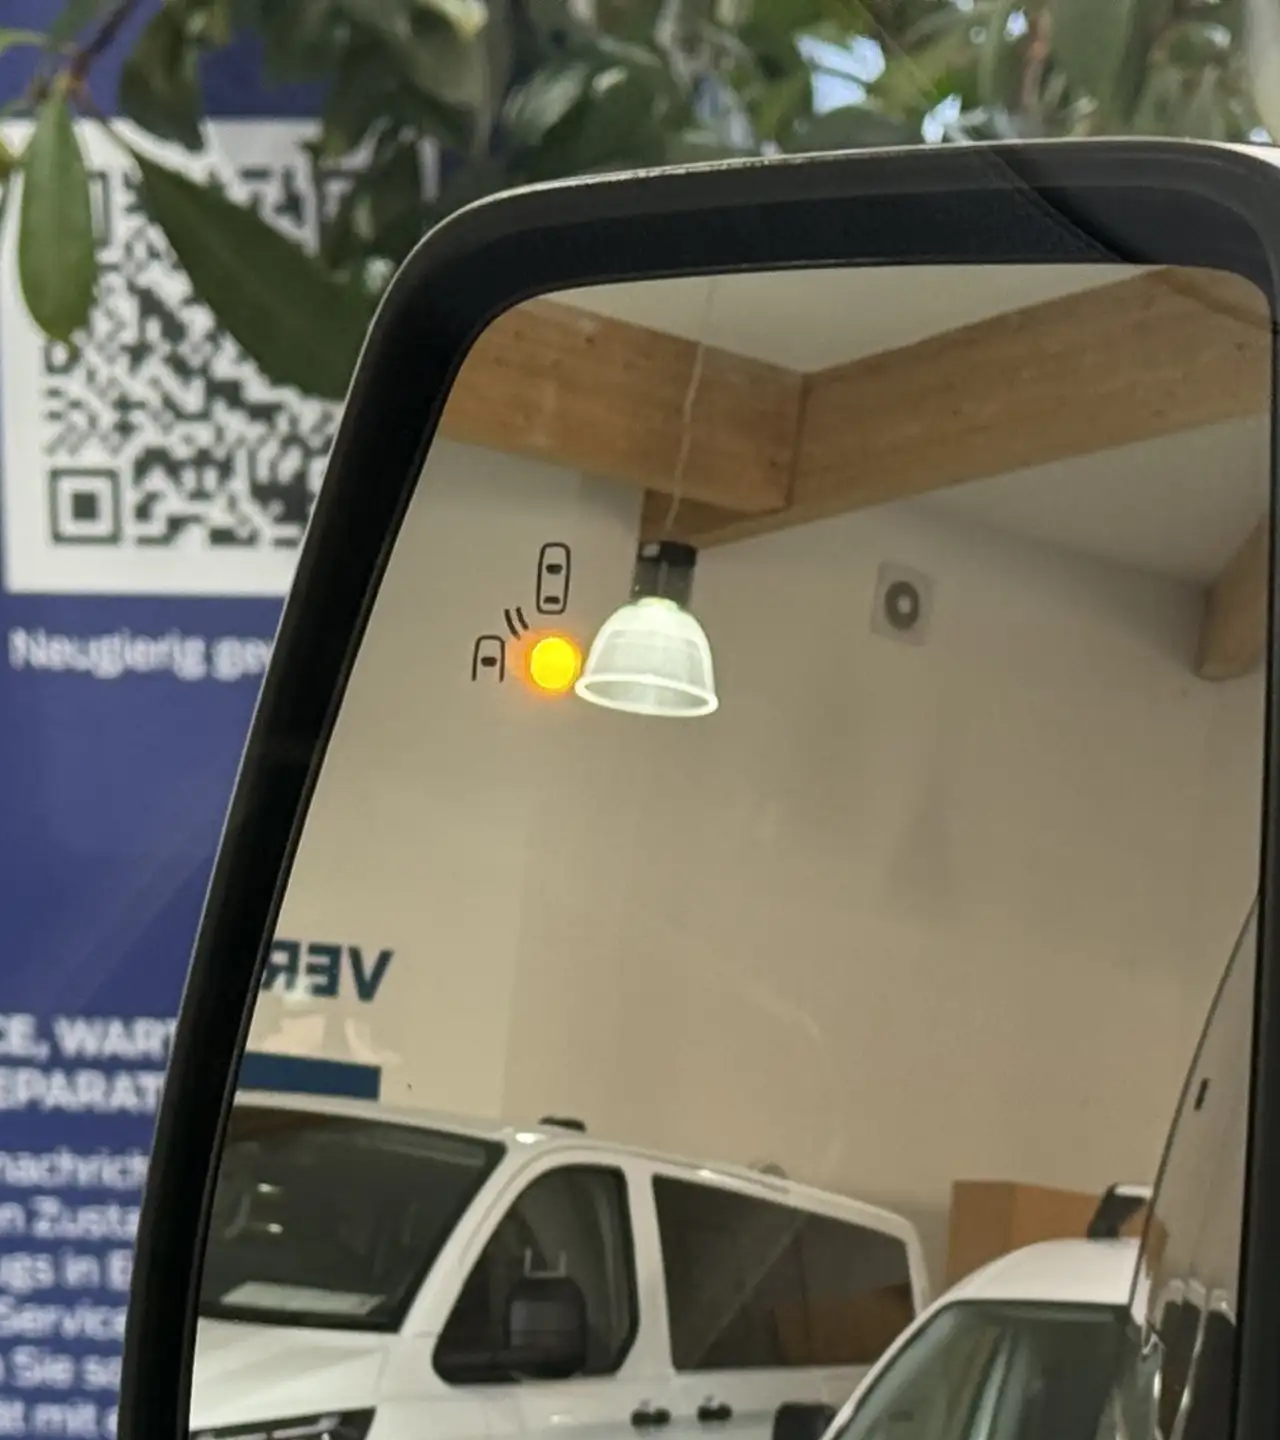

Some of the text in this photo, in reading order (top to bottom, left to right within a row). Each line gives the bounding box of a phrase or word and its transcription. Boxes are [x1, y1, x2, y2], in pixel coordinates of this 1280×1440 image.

[9, 628, 208, 681] Neugierig
[60, 1254, 101, 1288] in
[11, 1346, 76, 1388] Sie
[28, 1400, 98, 1438] mit
